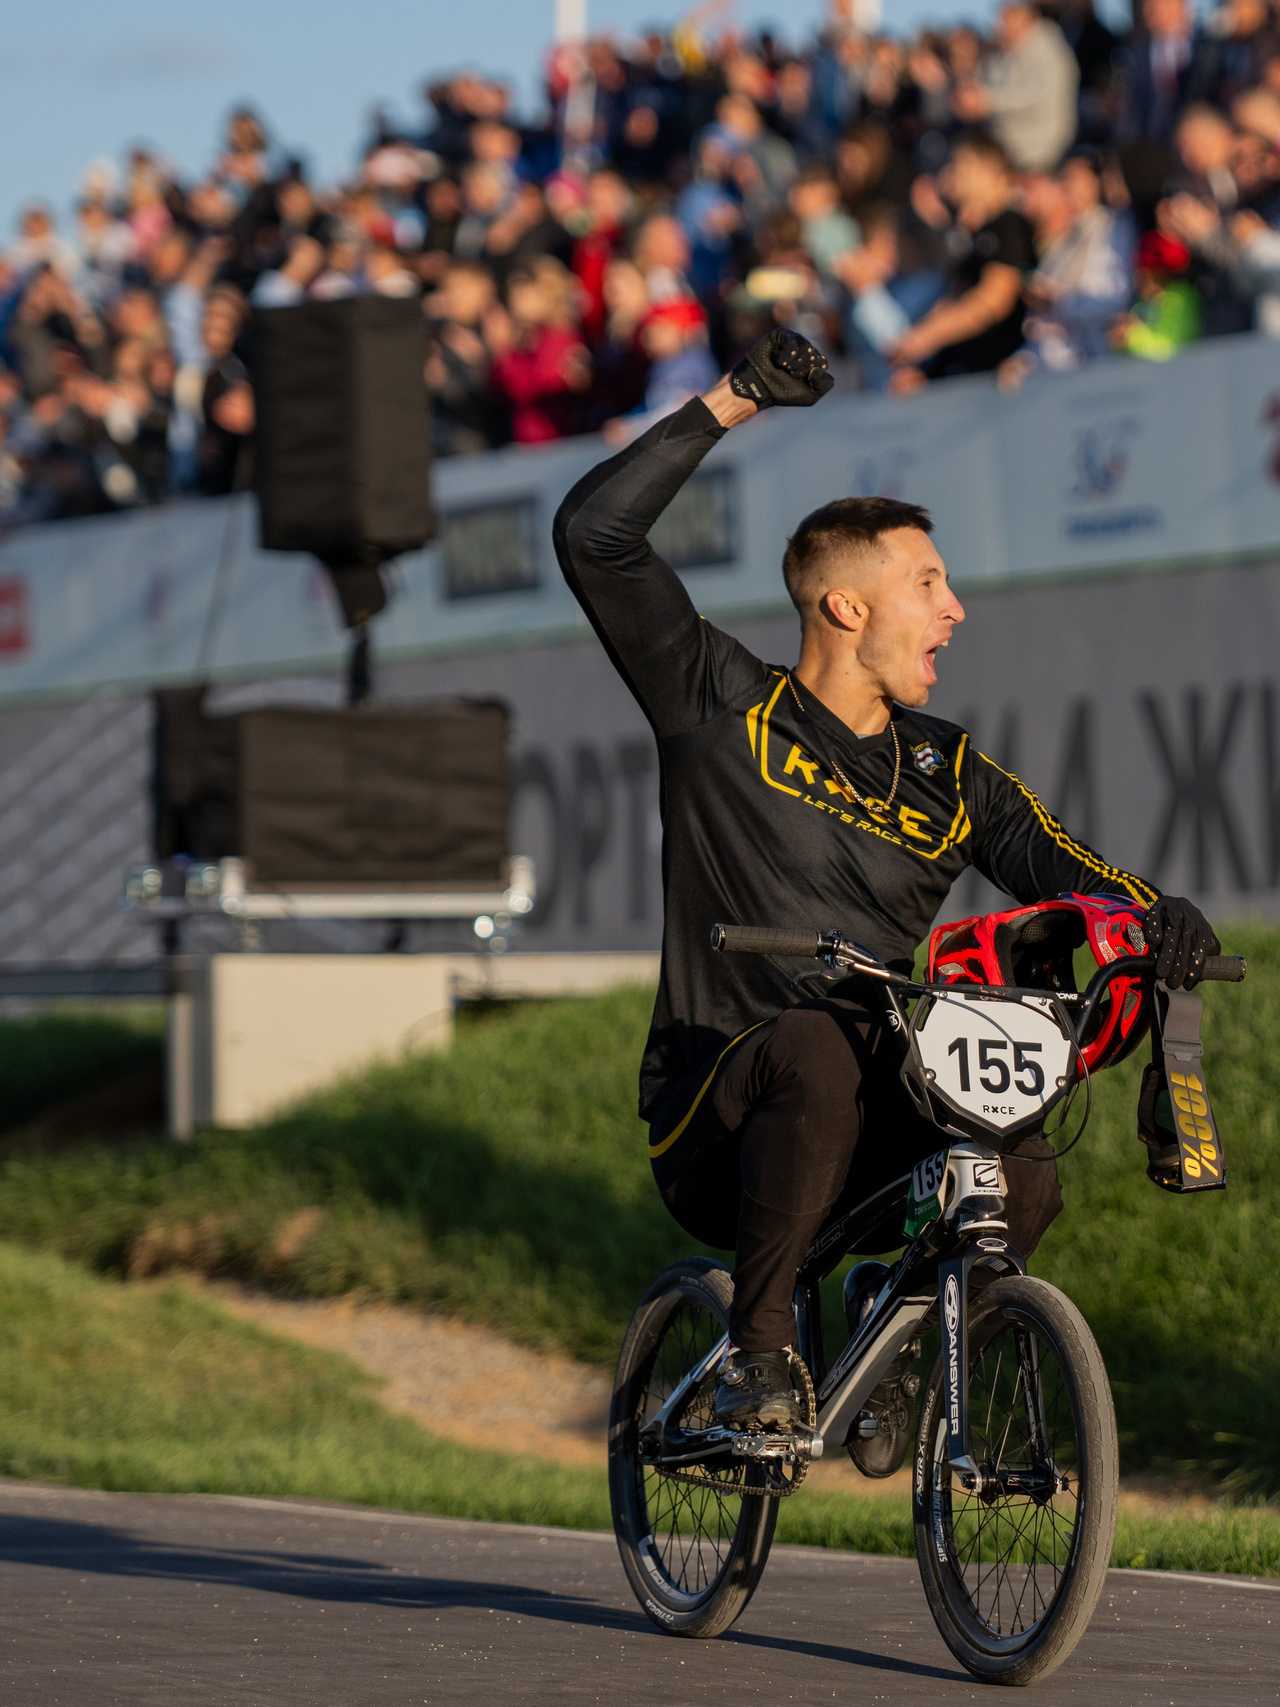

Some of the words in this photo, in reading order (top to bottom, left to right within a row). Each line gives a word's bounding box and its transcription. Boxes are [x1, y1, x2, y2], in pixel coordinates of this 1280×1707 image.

[803, 795, 855, 824] LET'S
[855, 820, 902, 845] RACE
[947, 1037, 1045, 1096] 155
[1170, 1070, 1218, 1178] 100%
[915, 1152, 945, 1195] 155
[948, 1332, 960, 1436] ANSWER
